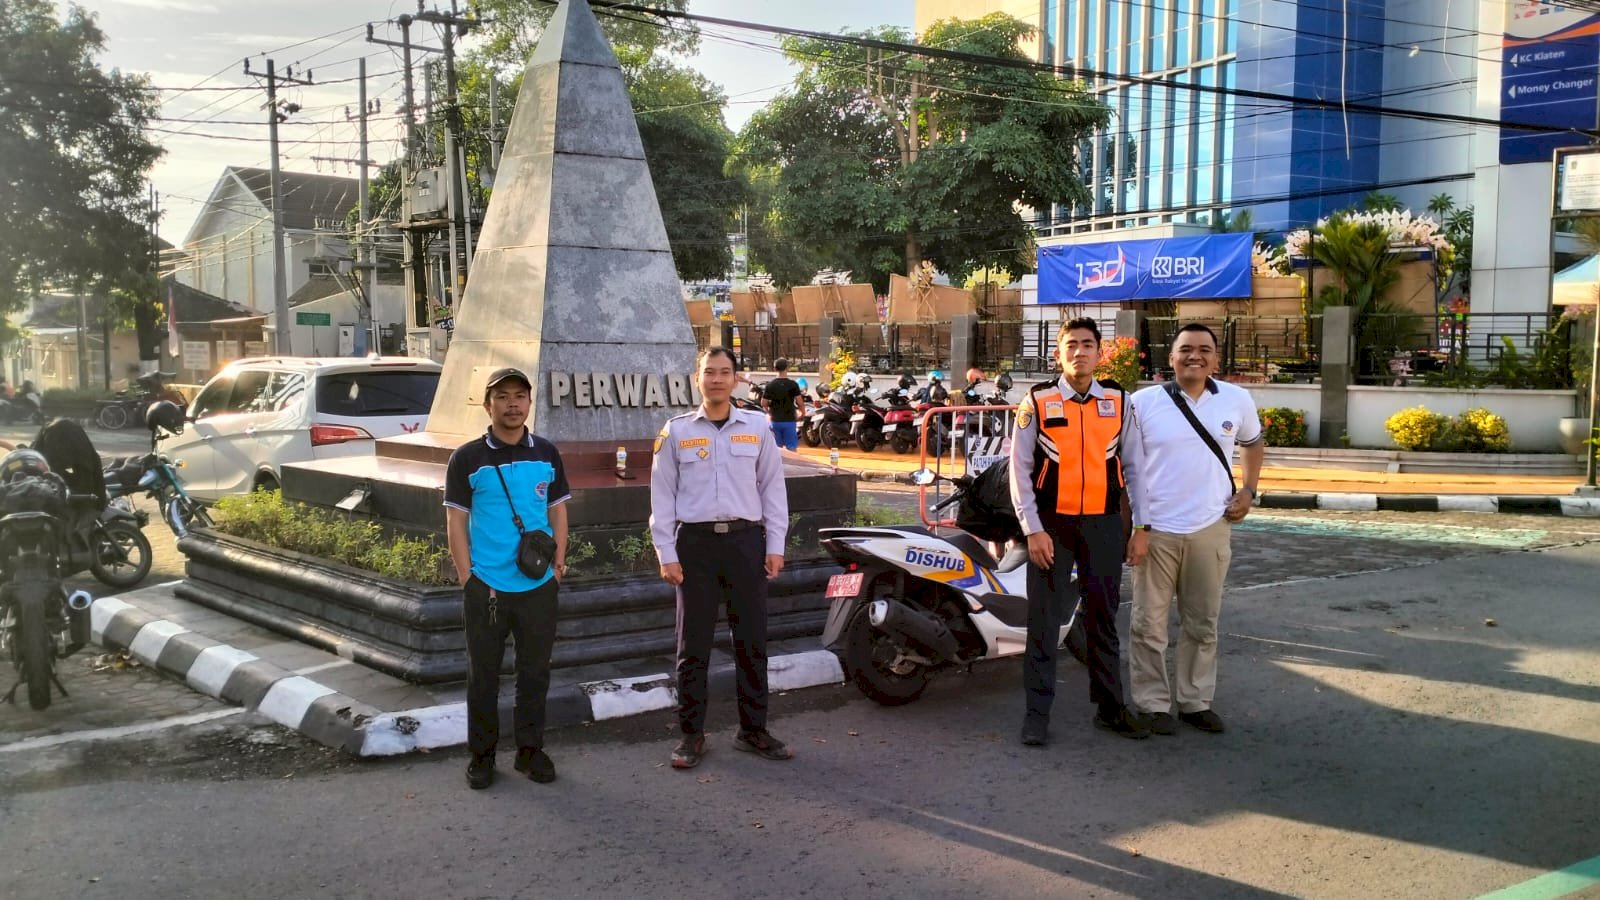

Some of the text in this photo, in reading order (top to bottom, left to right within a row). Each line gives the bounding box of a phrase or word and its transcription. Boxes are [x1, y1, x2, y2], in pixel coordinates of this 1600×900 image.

[1520, 51, 1565, 63] KC Klaten
[1517, 78, 1593, 94] Money Changer
[1174, 256, 1205, 276] BRI
[905, 549, 966, 572] DISHUB
